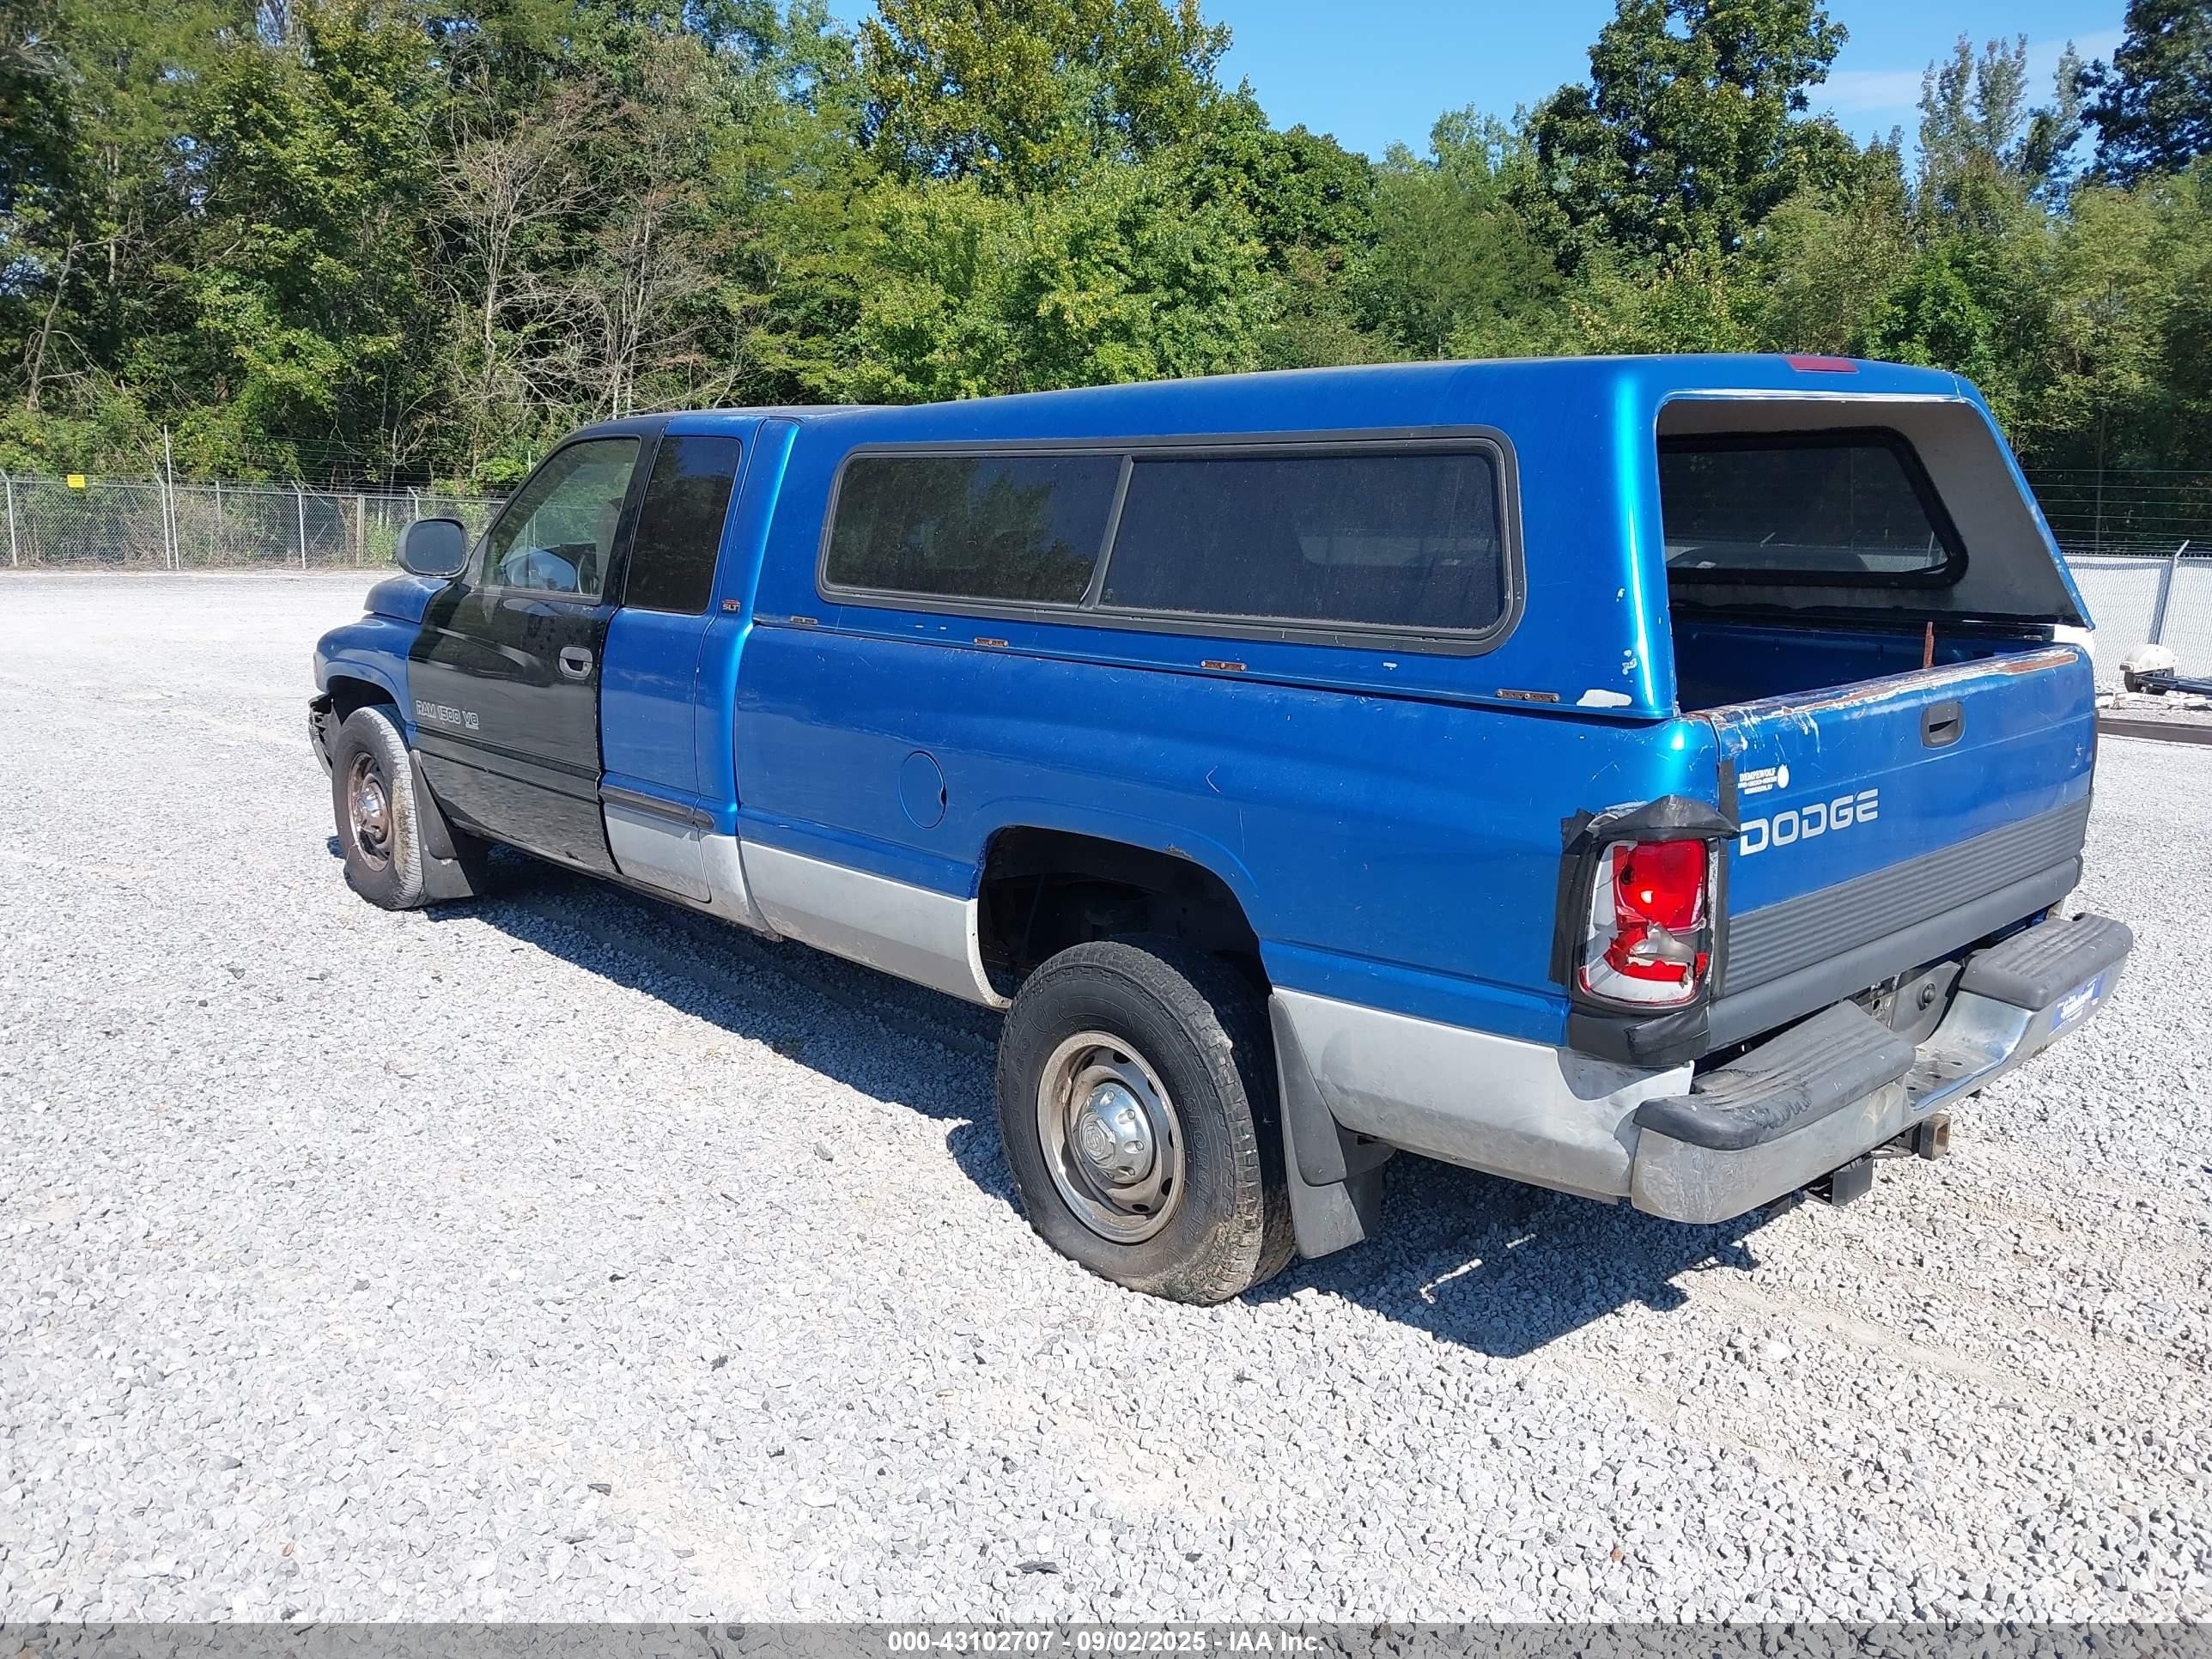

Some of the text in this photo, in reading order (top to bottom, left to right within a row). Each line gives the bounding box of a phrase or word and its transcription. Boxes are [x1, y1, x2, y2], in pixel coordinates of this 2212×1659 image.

[416, 700, 479, 726] RAM 1500 V8
[1740, 788, 1879, 857] DODGE
[1143, 1024, 1211, 1206] TRANSFORCE
